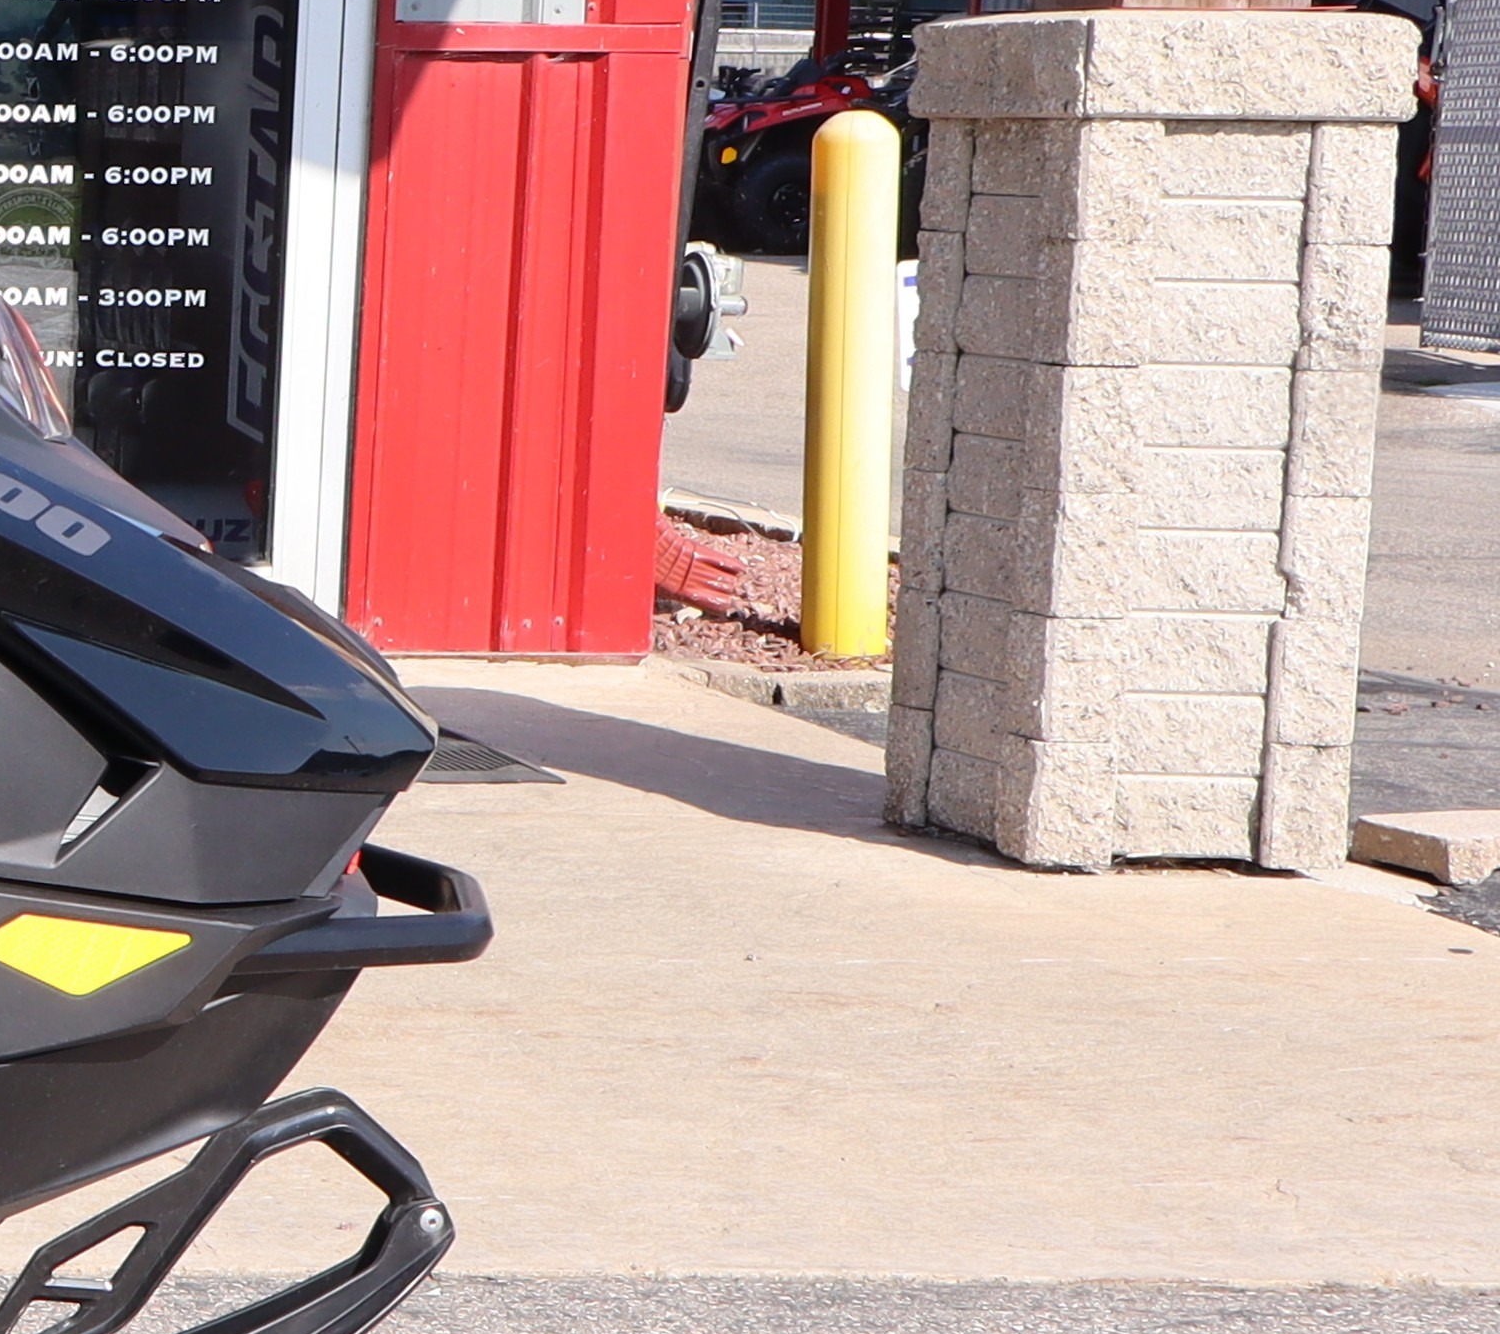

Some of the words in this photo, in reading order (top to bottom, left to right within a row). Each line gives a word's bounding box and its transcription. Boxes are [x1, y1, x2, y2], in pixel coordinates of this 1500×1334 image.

[109, 44, 219, 64] 6:00PM
[107, 105, 216, 125] 6:00PM
[104, 166, 214, 186] 6:00PM
[102, 227, 210, 247] 6:00PM
[98, 288, 207, 308] 3:00PM
[38, 349, 84, 367] UN:
[95, 348, 206, 368] CLOSED
